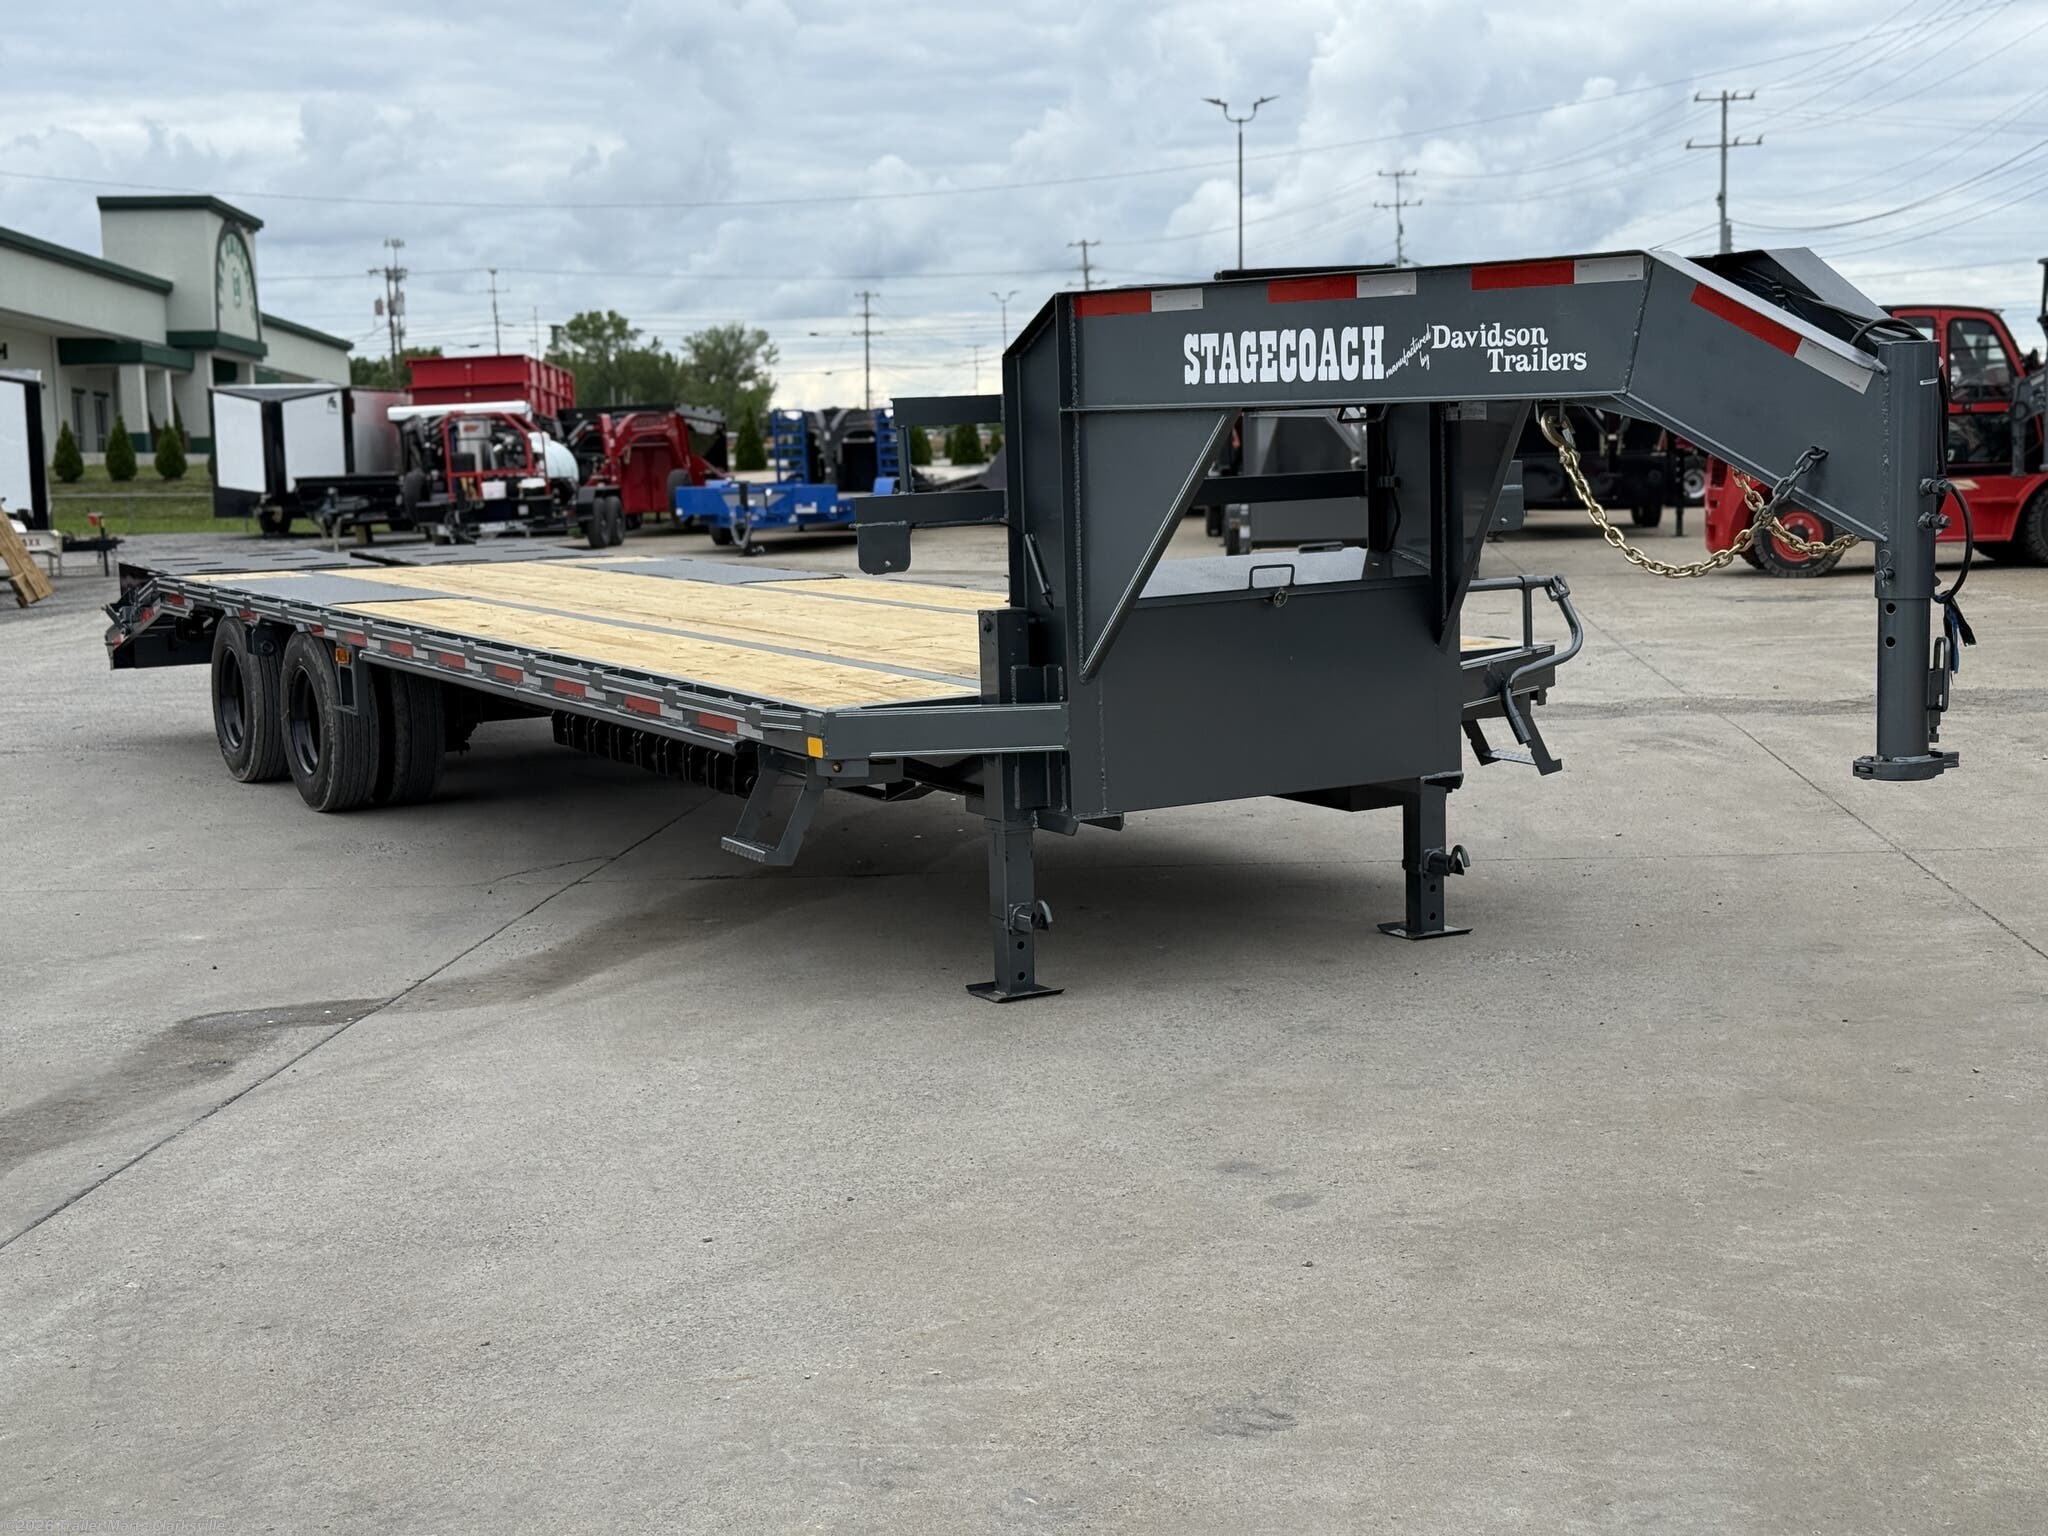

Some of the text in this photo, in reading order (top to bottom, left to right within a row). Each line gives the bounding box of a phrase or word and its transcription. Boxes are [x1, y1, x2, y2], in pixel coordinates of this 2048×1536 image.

[1431, 322, 1549, 349] Davidson
[1184, 325, 1385, 385] STAGECOACH
[1386, 323, 1431, 378] manufactured
[1419, 351, 1430, 370] by
[1487, 347, 1588, 373] Trailers
